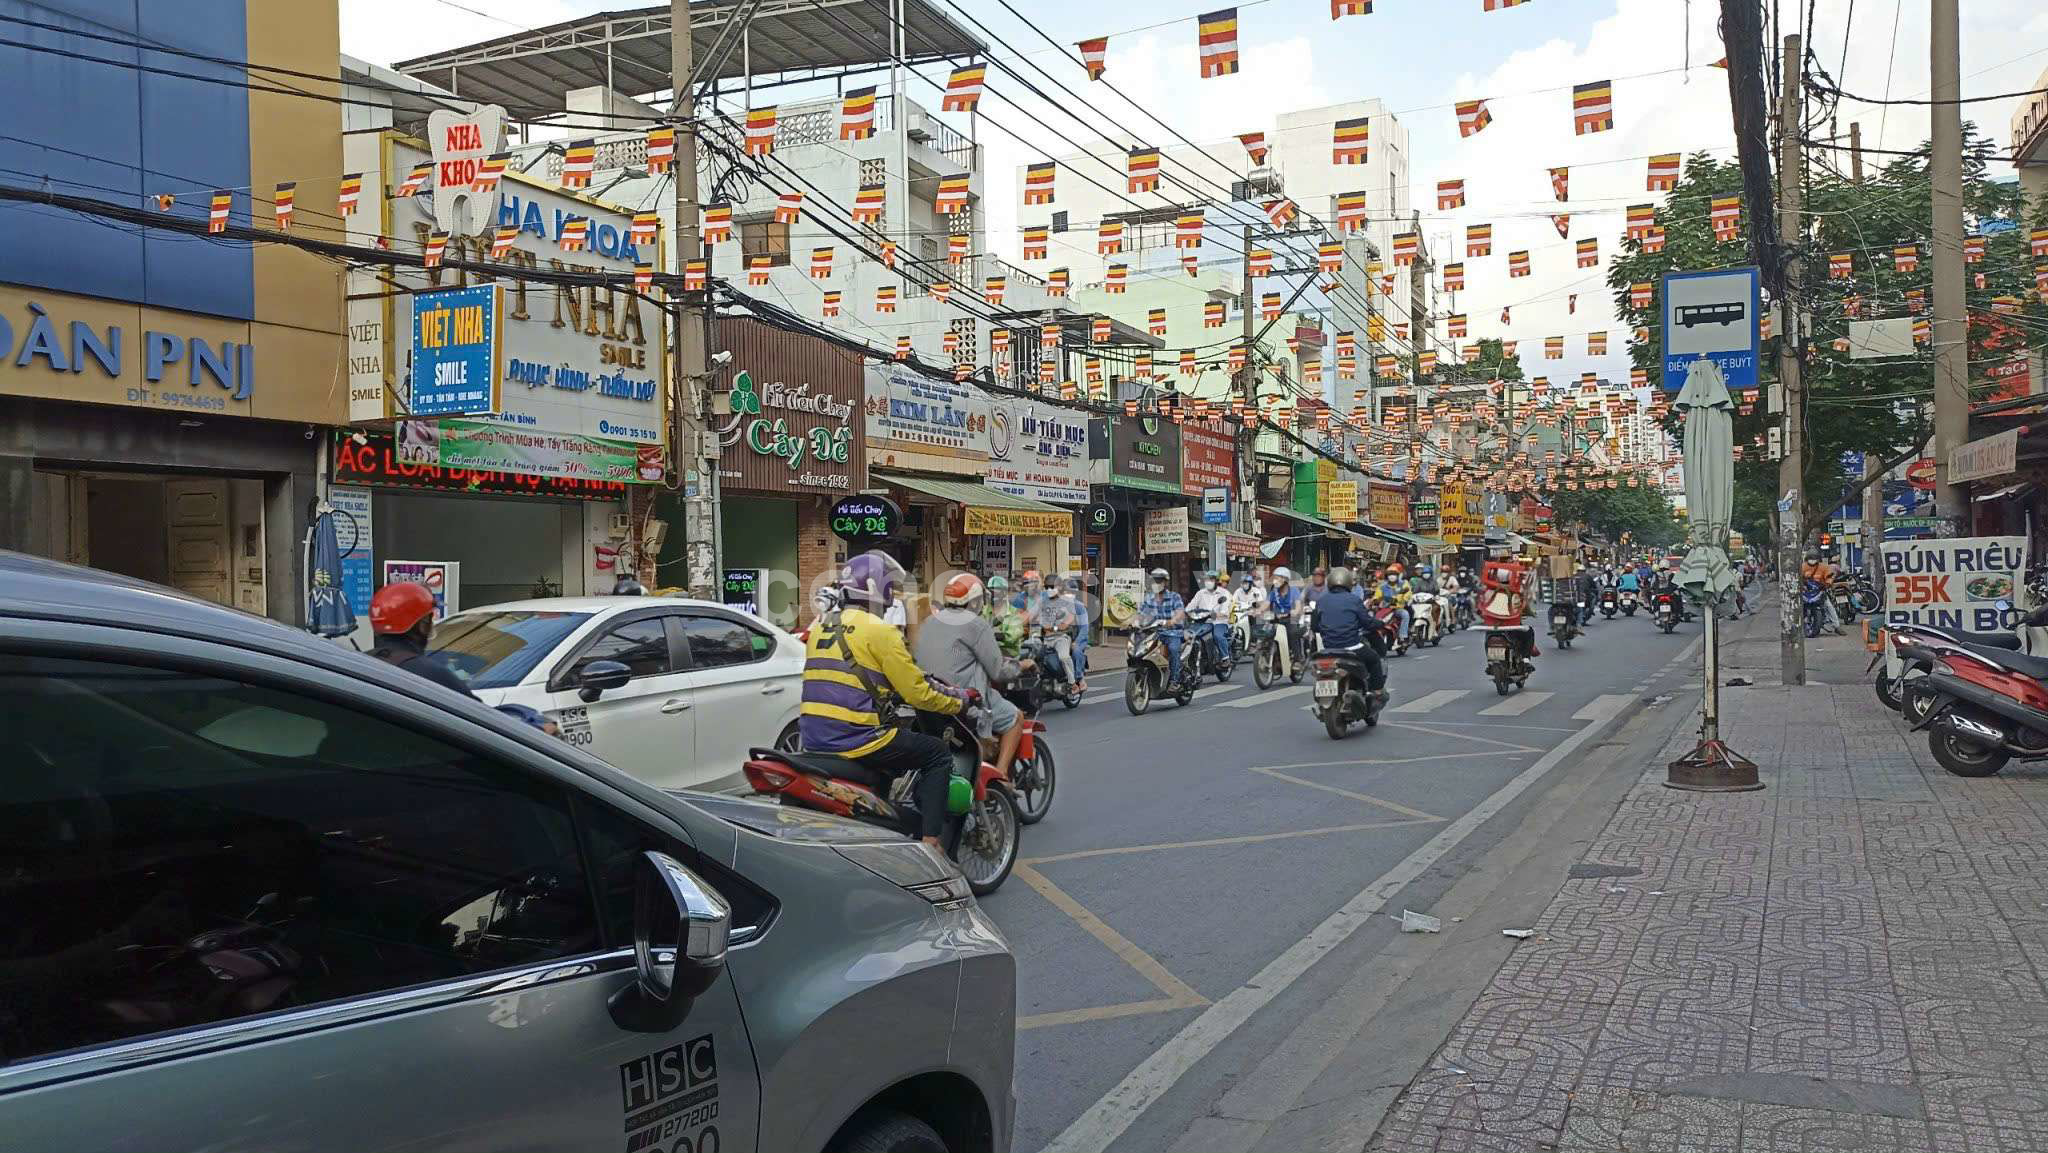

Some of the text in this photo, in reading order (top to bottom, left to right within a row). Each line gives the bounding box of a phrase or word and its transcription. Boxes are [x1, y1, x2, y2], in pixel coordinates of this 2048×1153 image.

[446, 124, 482, 152] NHA
[501, 193, 546, 238] HA
[350, 319, 381, 345] VIỆT
[421, 301, 484, 357] VIỆT NHA
[0, 301, 254, 401] ÀN PNJ
[1730, 354, 1752, 369] BUÝT
[350, 356, 381, 376] NHA
[435, 360, 468, 387] SMILE
[352, 388, 381, 401] SMILE
[814, 393, 856, 426] Chay
[890, 398, 928, 422] KIM
[930, 403, 967, 428] LÂN
[515, 434, 533, 448] Mùa
[610, 426, 627, 435] 0901
[630, 429, 639, 438] 35
[746, 418, 806, 470] Cây
[808, 426, 854, 464] Đề
[336, 438, 377, 473] ÁC
[564, 461, 588, 475] 50%
[829, 475, 849, 489] 1992
[864, 504, 884, 516] Chay
[833, 517, 862, 535] Cây
[1885, 541, 2023, 574] BÚN RIÊU
[725, 580, 741, 593] Cây
[1894, 574, 1952, 604] 35K
[560, 706, 588, 722] HSC
[621, 1034, 717, 1110] HSC
[663, 1101, 719, 1140] 277200
